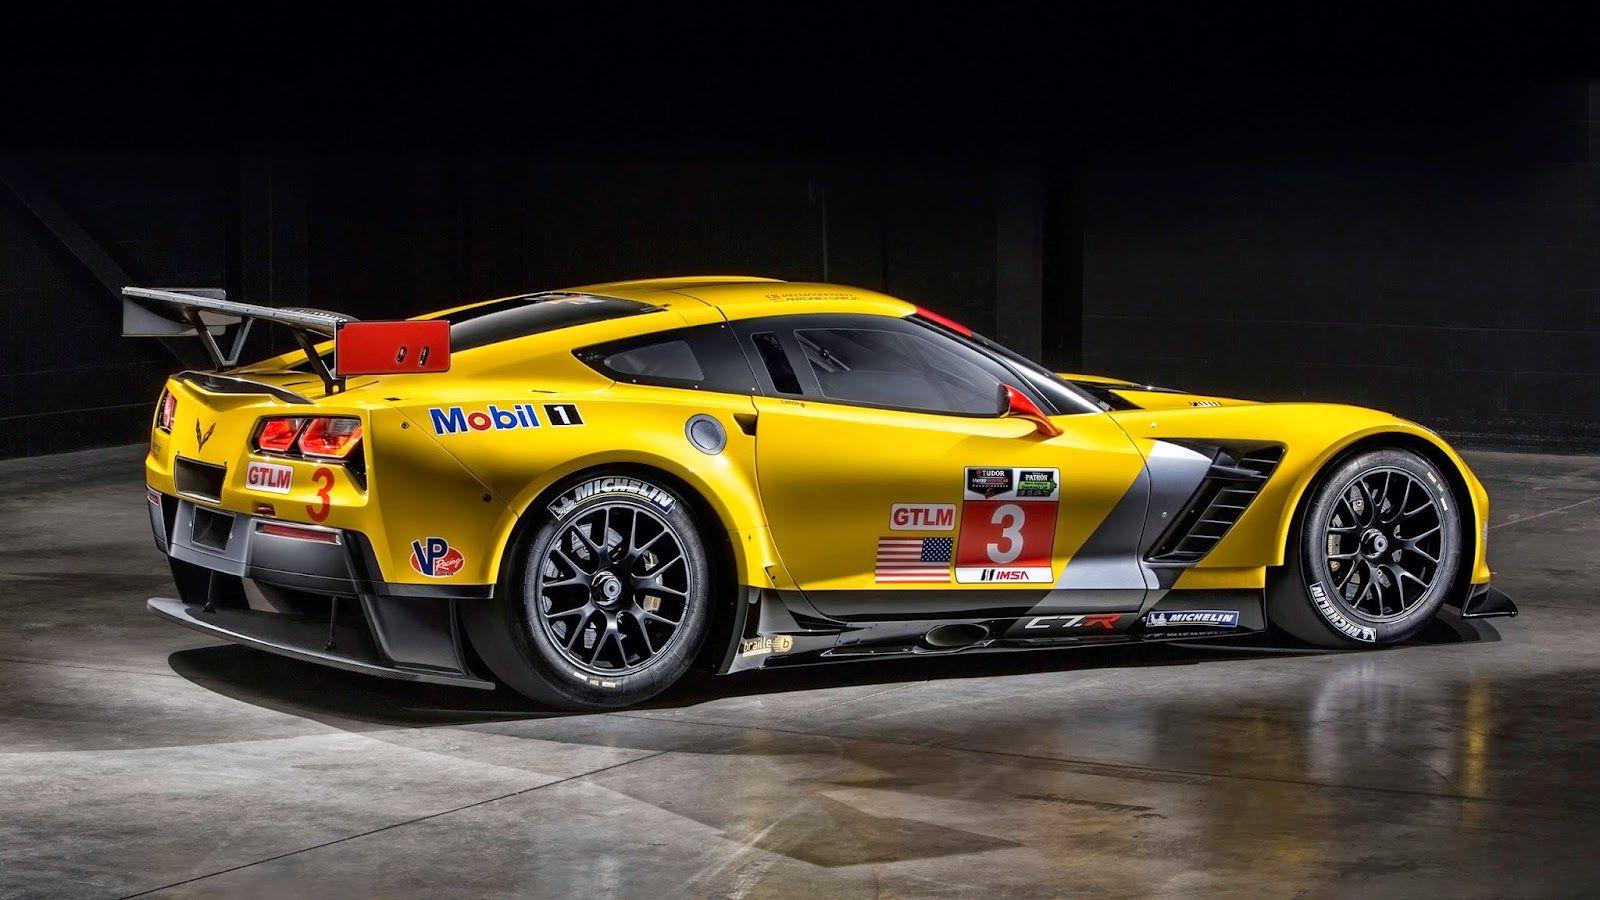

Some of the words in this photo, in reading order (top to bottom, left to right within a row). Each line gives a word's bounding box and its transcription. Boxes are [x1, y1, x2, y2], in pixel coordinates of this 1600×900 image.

[429, 404, 540, 434] Mobil
[248, 466, 291, 489] GTLM
[305, 467, 335, 523] 3
[574, 478, 674, 508] MICHELIN
[893, 508, 953, 526] GTLM
[986, 503, 1026, 564] 3
[410, 537, 449, 576] VP
[996, 571, 1030, 580] IMSA
[1168, 613, 1234, 623] MICHELIN
[1311, 586, 1362, 638] MICHELIN
[744, 636, 772, 652] braille
